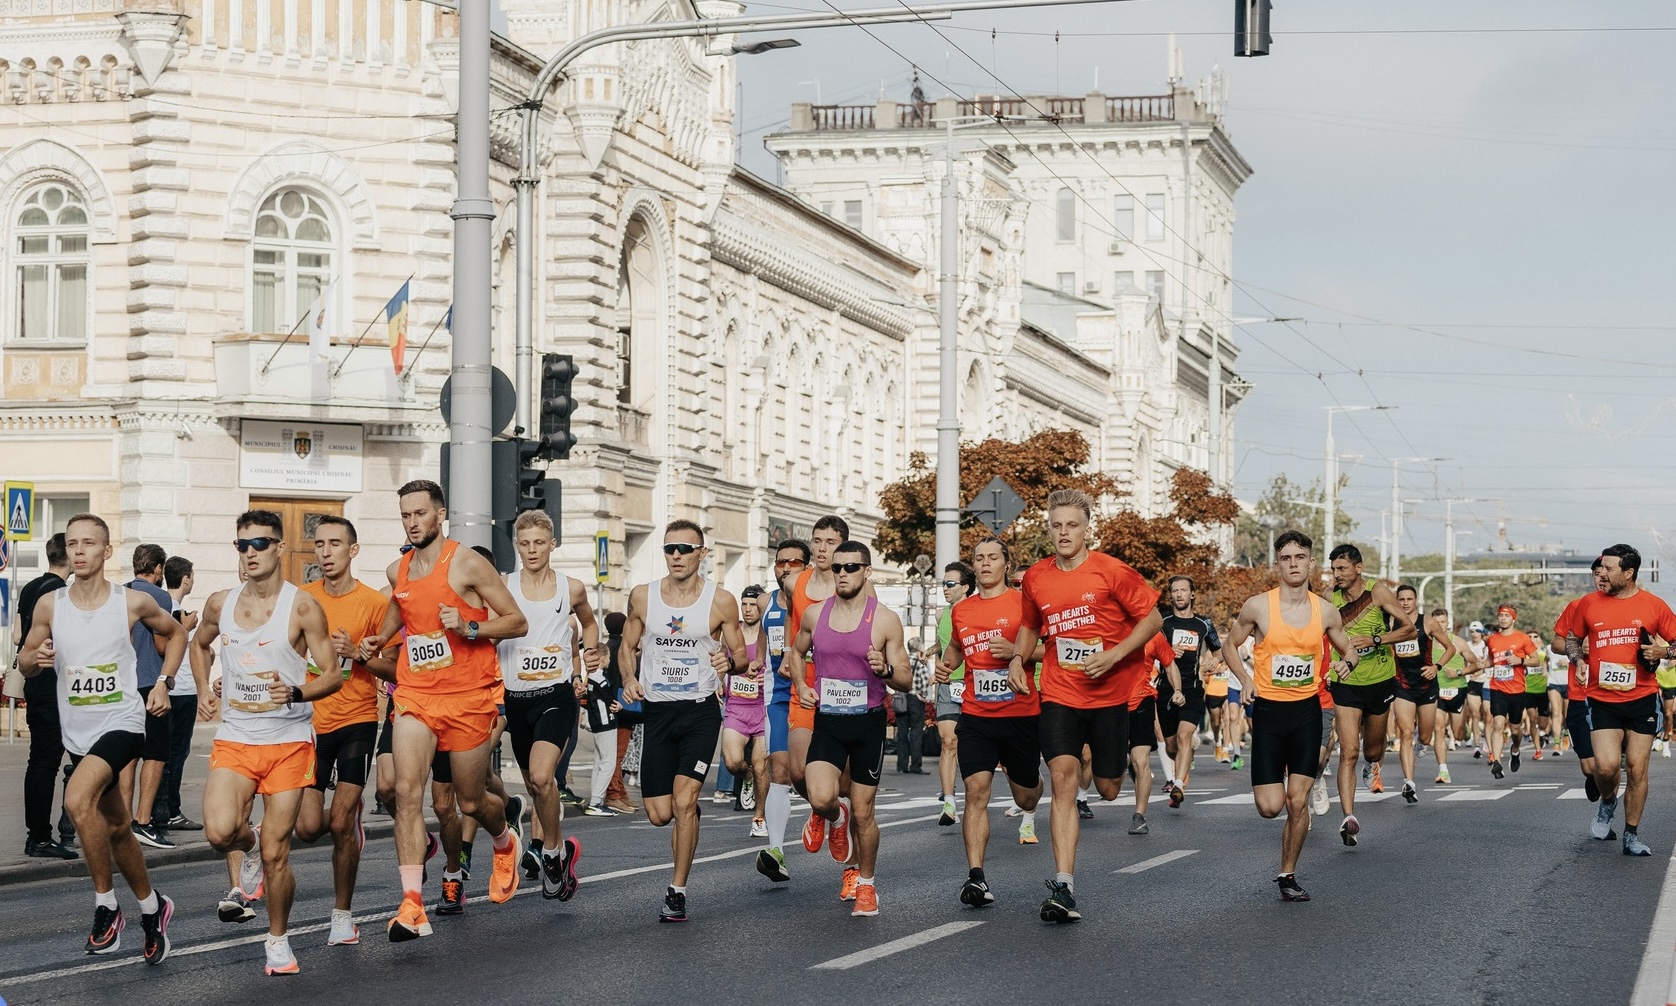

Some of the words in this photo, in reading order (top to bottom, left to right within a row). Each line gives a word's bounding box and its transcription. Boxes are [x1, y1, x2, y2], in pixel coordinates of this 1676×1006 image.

[1048, 613, 1060, 624] OUR
[1062, 605, 1089, 620] HEARTS
[1058, 615, 1095, 632] TOGETHER
[963, 635, 975, 646] OUR
[977, 629, 1002, 641] HEARTS
[1598, 630, 1610, 638] OUR
[1612, 628, 1636, 636] HEARTS
[656, 638, 698, 647] SAYSKY
[1609, 637, 1639, 645] TOGETHER
[412, 642, 444, 662] 3050
[1398, 644, 1415, 652] 2779
[522, 656, 558, 670] 3052
[662, 667, 689, 676] SIURIS
[1276, 664, 1311, 678] 4954
[1604, 671, 1631, 683] 2551
[71, 676, 116, 693] 4403
[734, 682, 754, 692] 3065
[979, 679, 1007, 692] 1469
[533, 687, 554, 697] PRO
[827, 689, 861, 697] PAVLENCO
